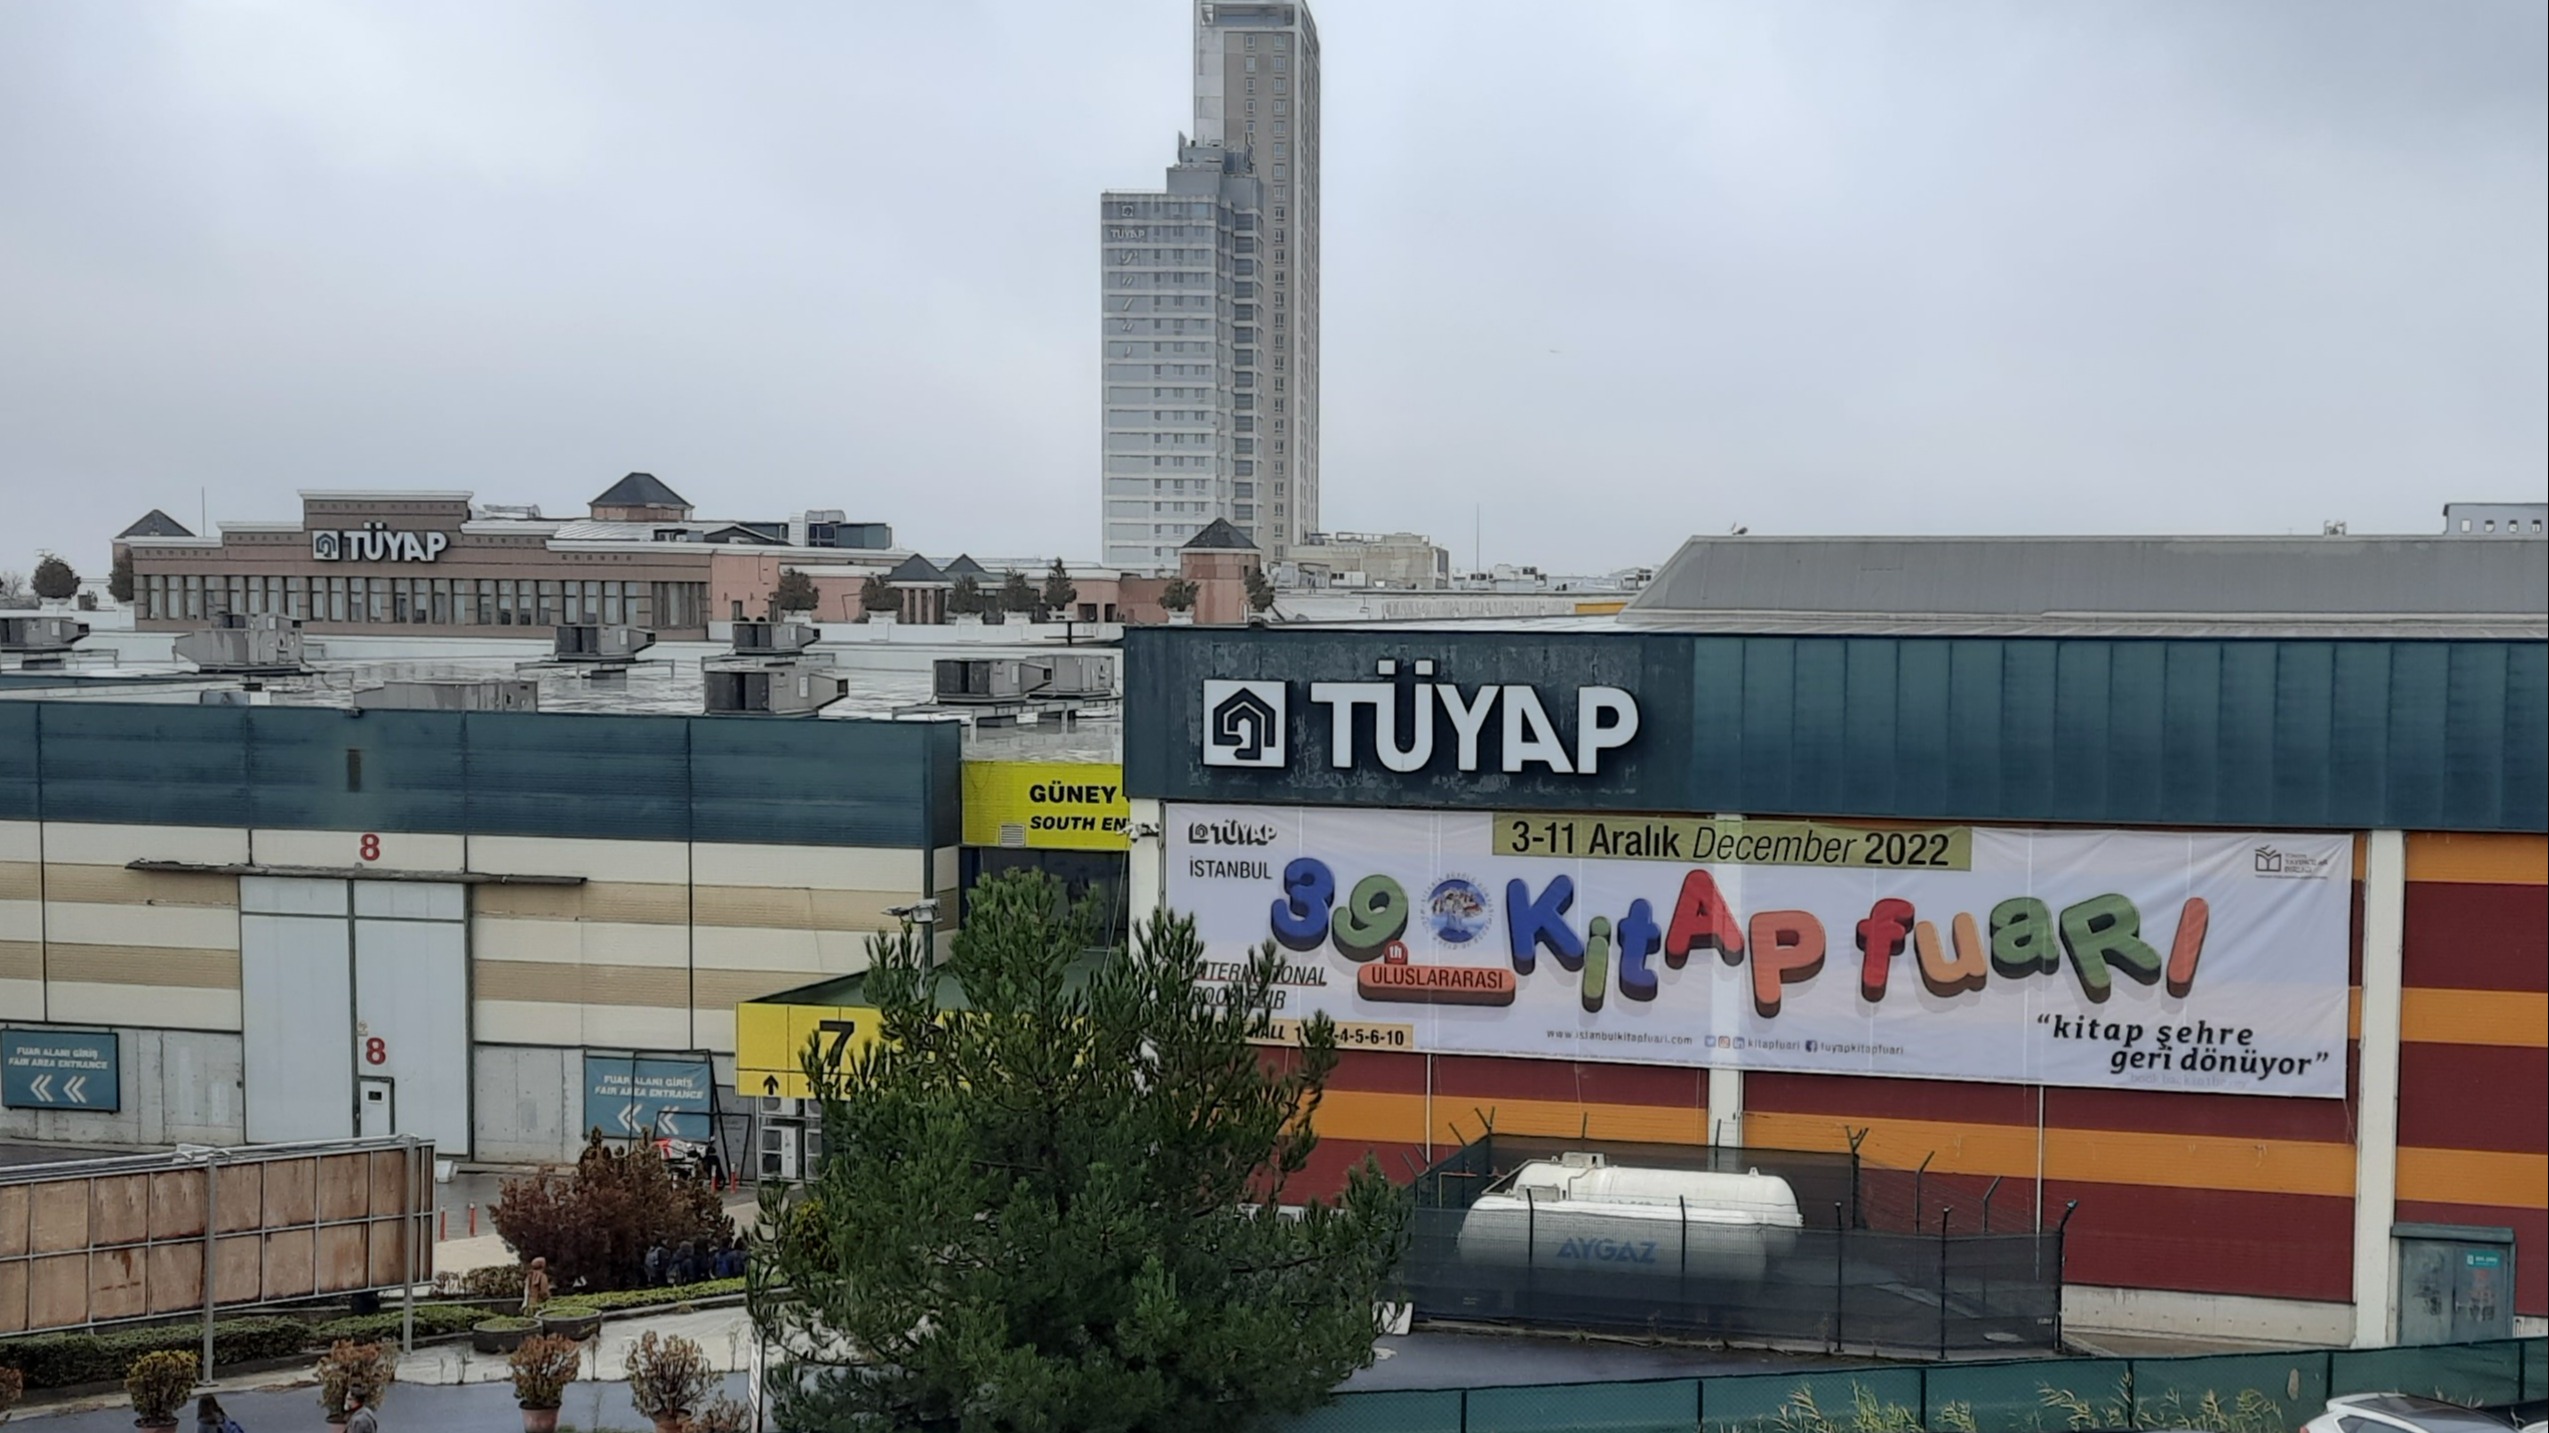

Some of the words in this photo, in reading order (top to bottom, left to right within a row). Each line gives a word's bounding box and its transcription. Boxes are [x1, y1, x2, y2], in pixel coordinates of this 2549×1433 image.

[344, 522, 447, 561] TÜYAP
[1310, 659, 1639, 774] TÜYAP
[1029, 780, 1117, 804] GÜNEY
[1030, 815, 1096, 831] SOUTH
[1101, 817, 1130, 831] EN
[1209, 819, 1278, 846] TÜYAP
[358, 833, 381, 862] 8
[1511, 820, 1574, 854] 3-11
[1588, 823, 1681, 857] Aralık
[1692, 826, 1857, 863] December
[1864, 832, 1950, 866] 2022
[1189, 855, 1273, 880] İSTANBUL
[1271, 857, 1410, 963] 39
[1389, 944, 1403, 960] th
[1371, 966, 1504, 989] ULUSLARARASI
[818, 1020, 855, 1067] 7
[2156, 1020, 2254, 1050] şehre
[8, 1057, 29, 1067] FAIR
[31, 1058, 55, 1068] AREA
[58, 1060, 108, 1069] ENTRANCE
[16, 1047, 41, 1056] FUAR
[43, 1048, 71, 1057] ALANI
[72, 1048, 99, 1060] GİRİŞ
[366, 1037, 386, 1065] 8
[2110, 1047, 2173, 1075] geri
[595, 1086, 617, 1096] FAIR
[649, 1088, 704, 1100] ENTRANCE
[604, 1075, 631, 1085] FUAR
[665, 1077, 693, 1089] GİRİŞ
[1556, 1237, 1659, 1264] AYGAZ
